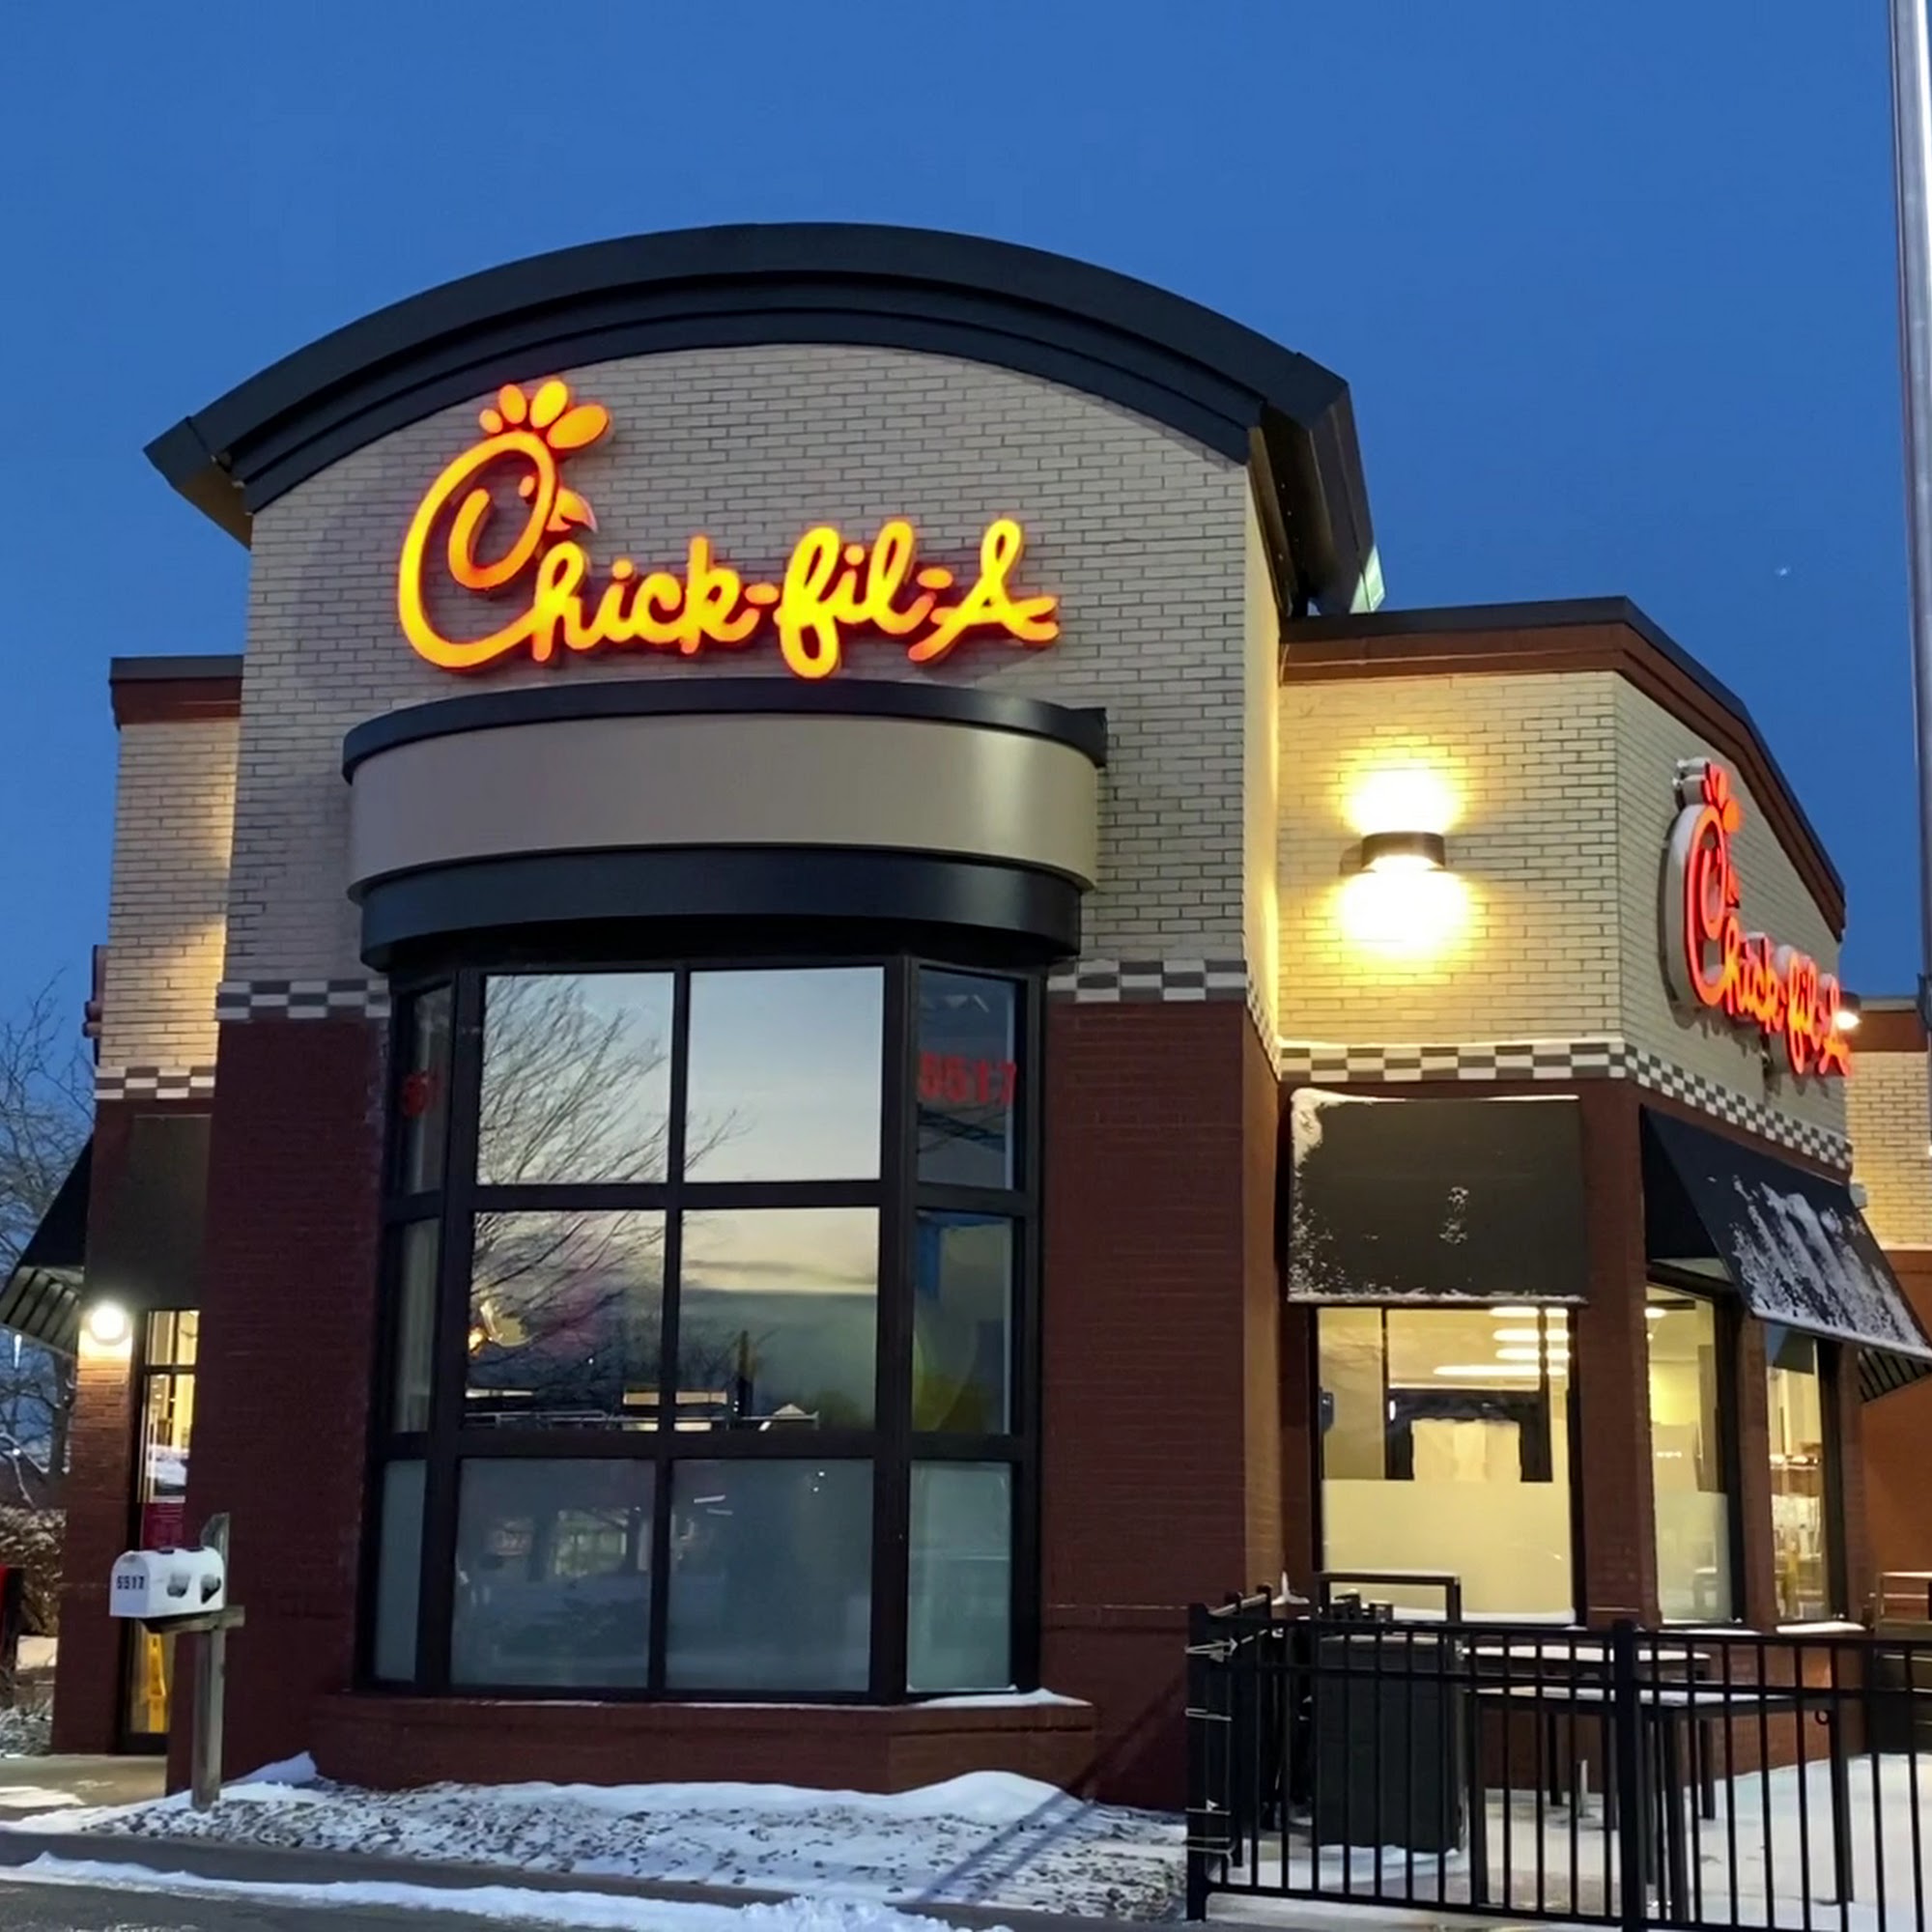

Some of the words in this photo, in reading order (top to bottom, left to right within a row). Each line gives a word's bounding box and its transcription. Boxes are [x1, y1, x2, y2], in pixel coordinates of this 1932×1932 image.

[397, 380, 1059, 679] Chick-fil-A
[1681, 759, 1852, 1076] Chick-fil-A
[116, 1576, 145, 1590] 5517
